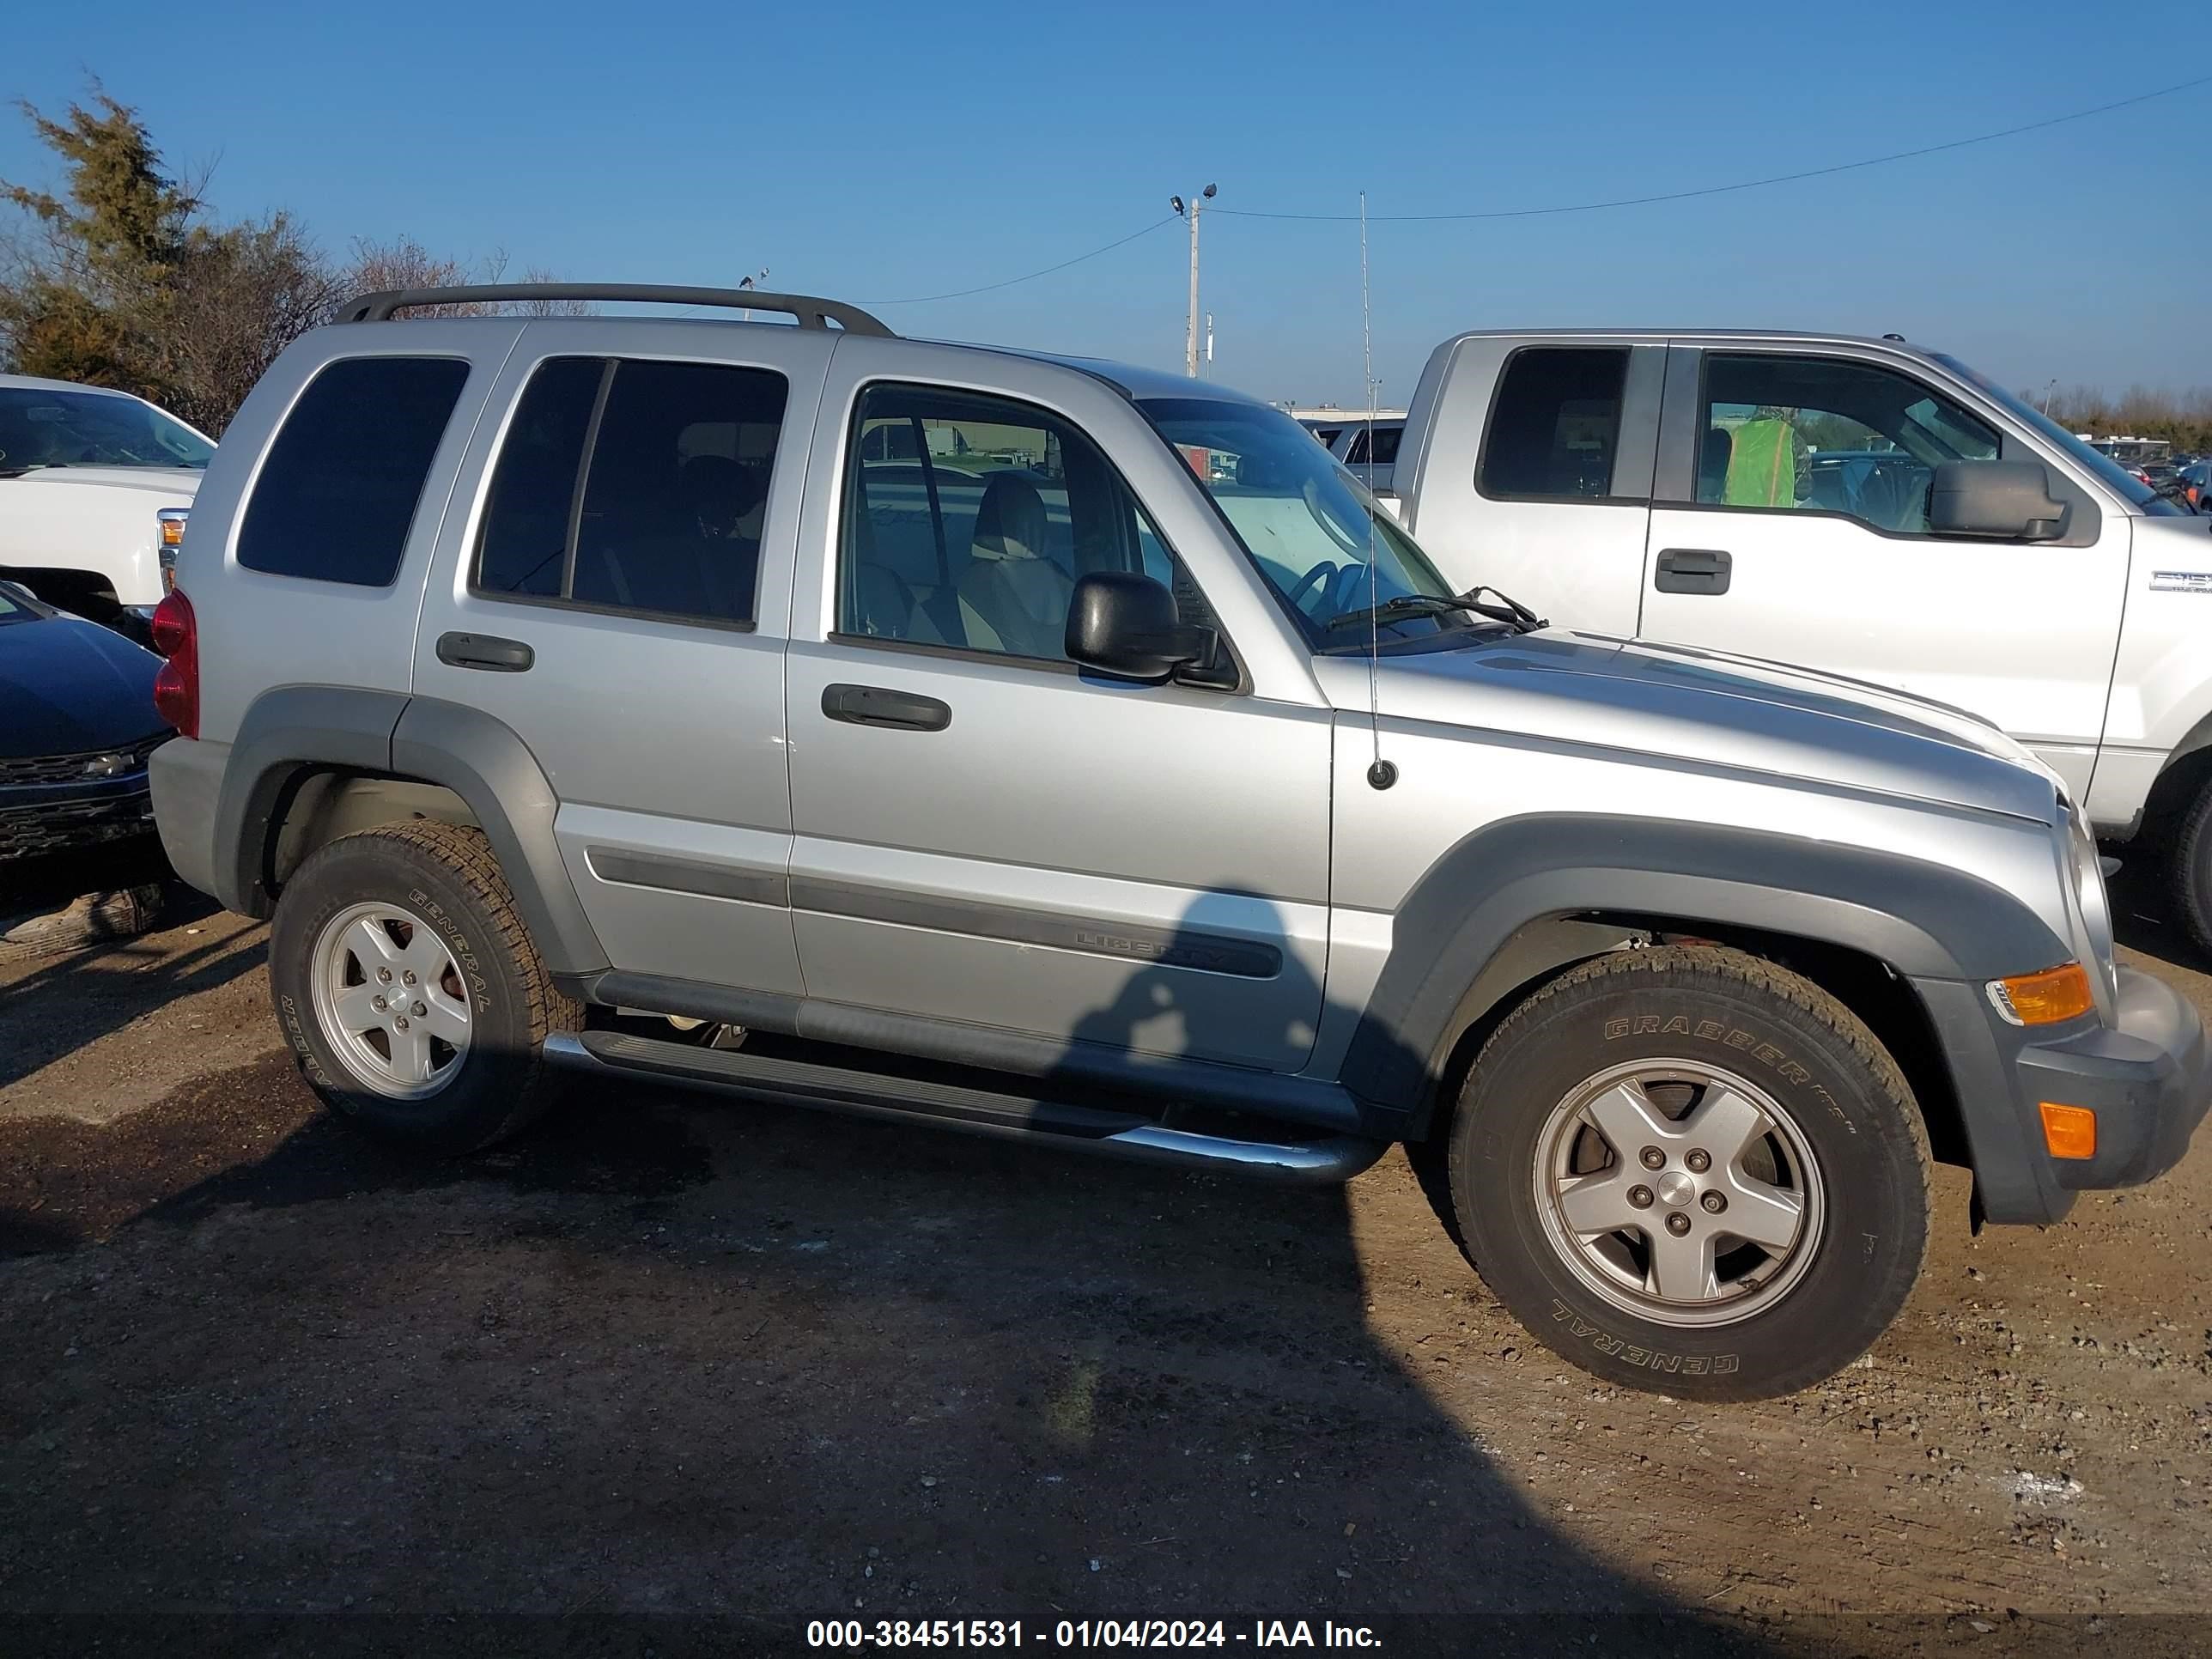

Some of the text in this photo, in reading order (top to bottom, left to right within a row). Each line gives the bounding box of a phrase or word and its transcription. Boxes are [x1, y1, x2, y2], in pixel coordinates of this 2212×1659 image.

[409, 888, 491, 1014] GENERAL
[1075, 932, 1226, 963] LIBERTY
[1604, 1015, 1811, 1085] GRABBER
[1553, 1298, 1740, 1375] GENERAL
